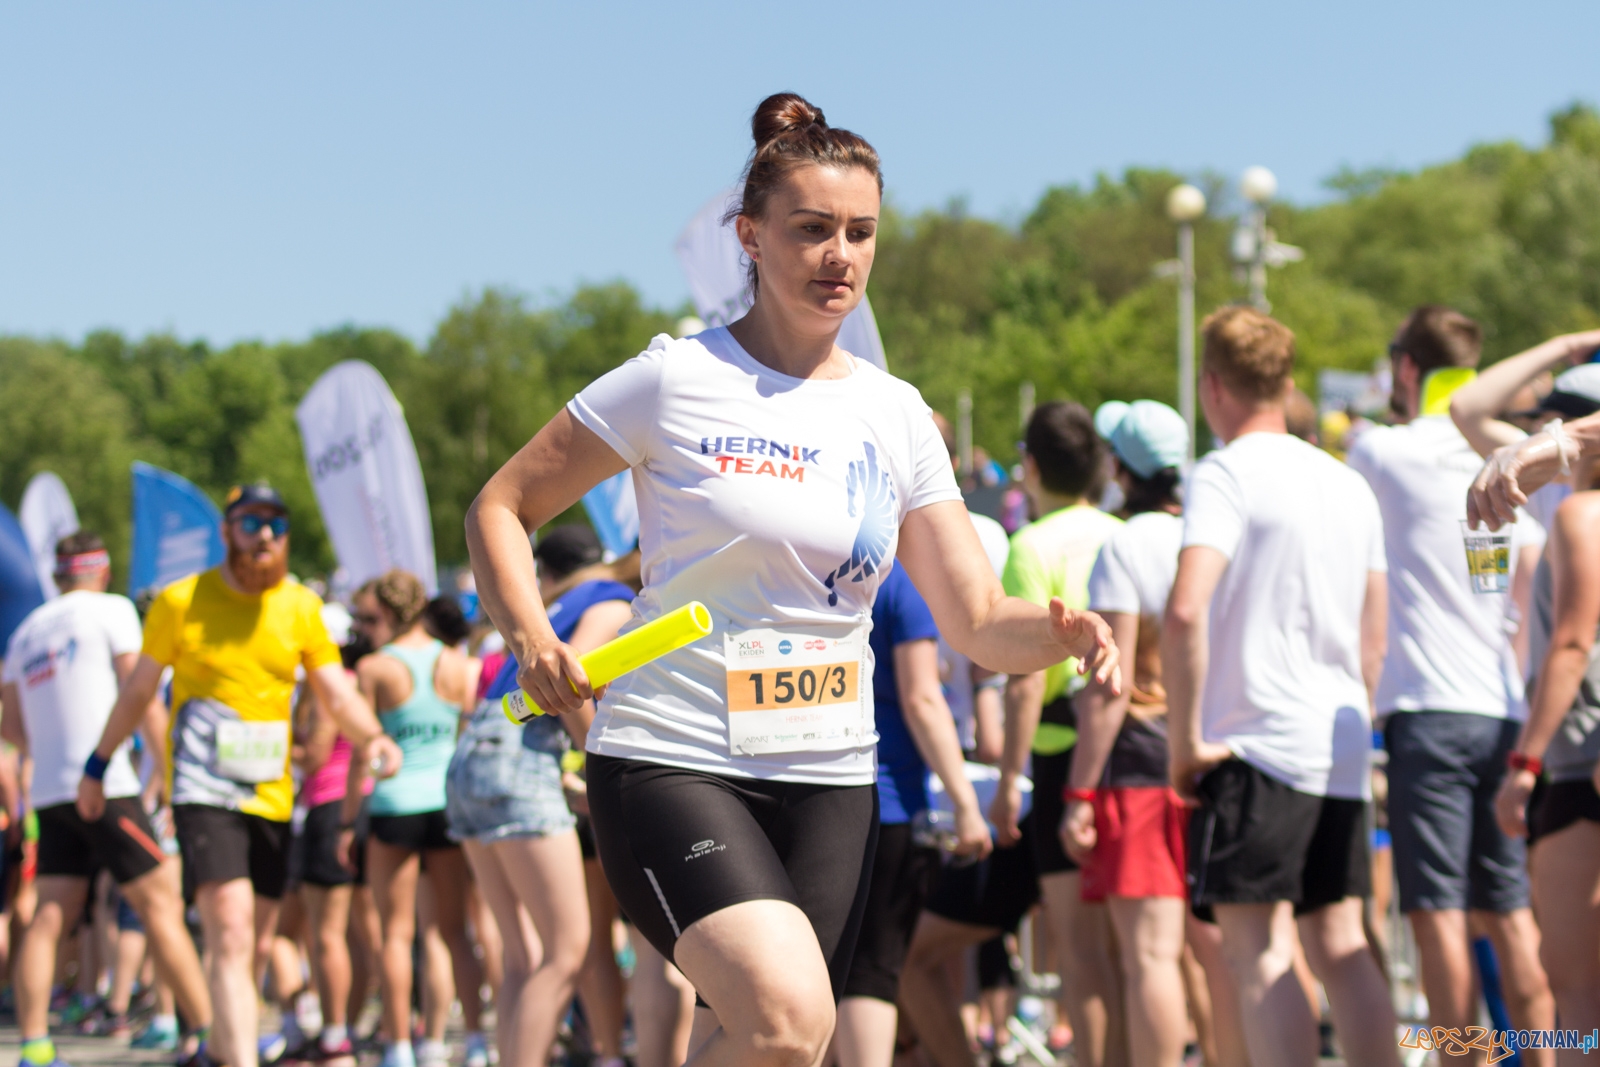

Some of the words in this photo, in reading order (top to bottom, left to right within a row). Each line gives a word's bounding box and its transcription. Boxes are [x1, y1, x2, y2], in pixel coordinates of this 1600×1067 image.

[700, 437, 822, 465] HERNIK
[715, 455, 805, 483] TEAM
[738, 649, 765, 657] EKIDEN
[749, 666, 846, 704] 150/3
[785, 714, 808, 723] HERNIK
[744, 735, 769, 743] APART
[684, 843, 727, 862] Kalenji
